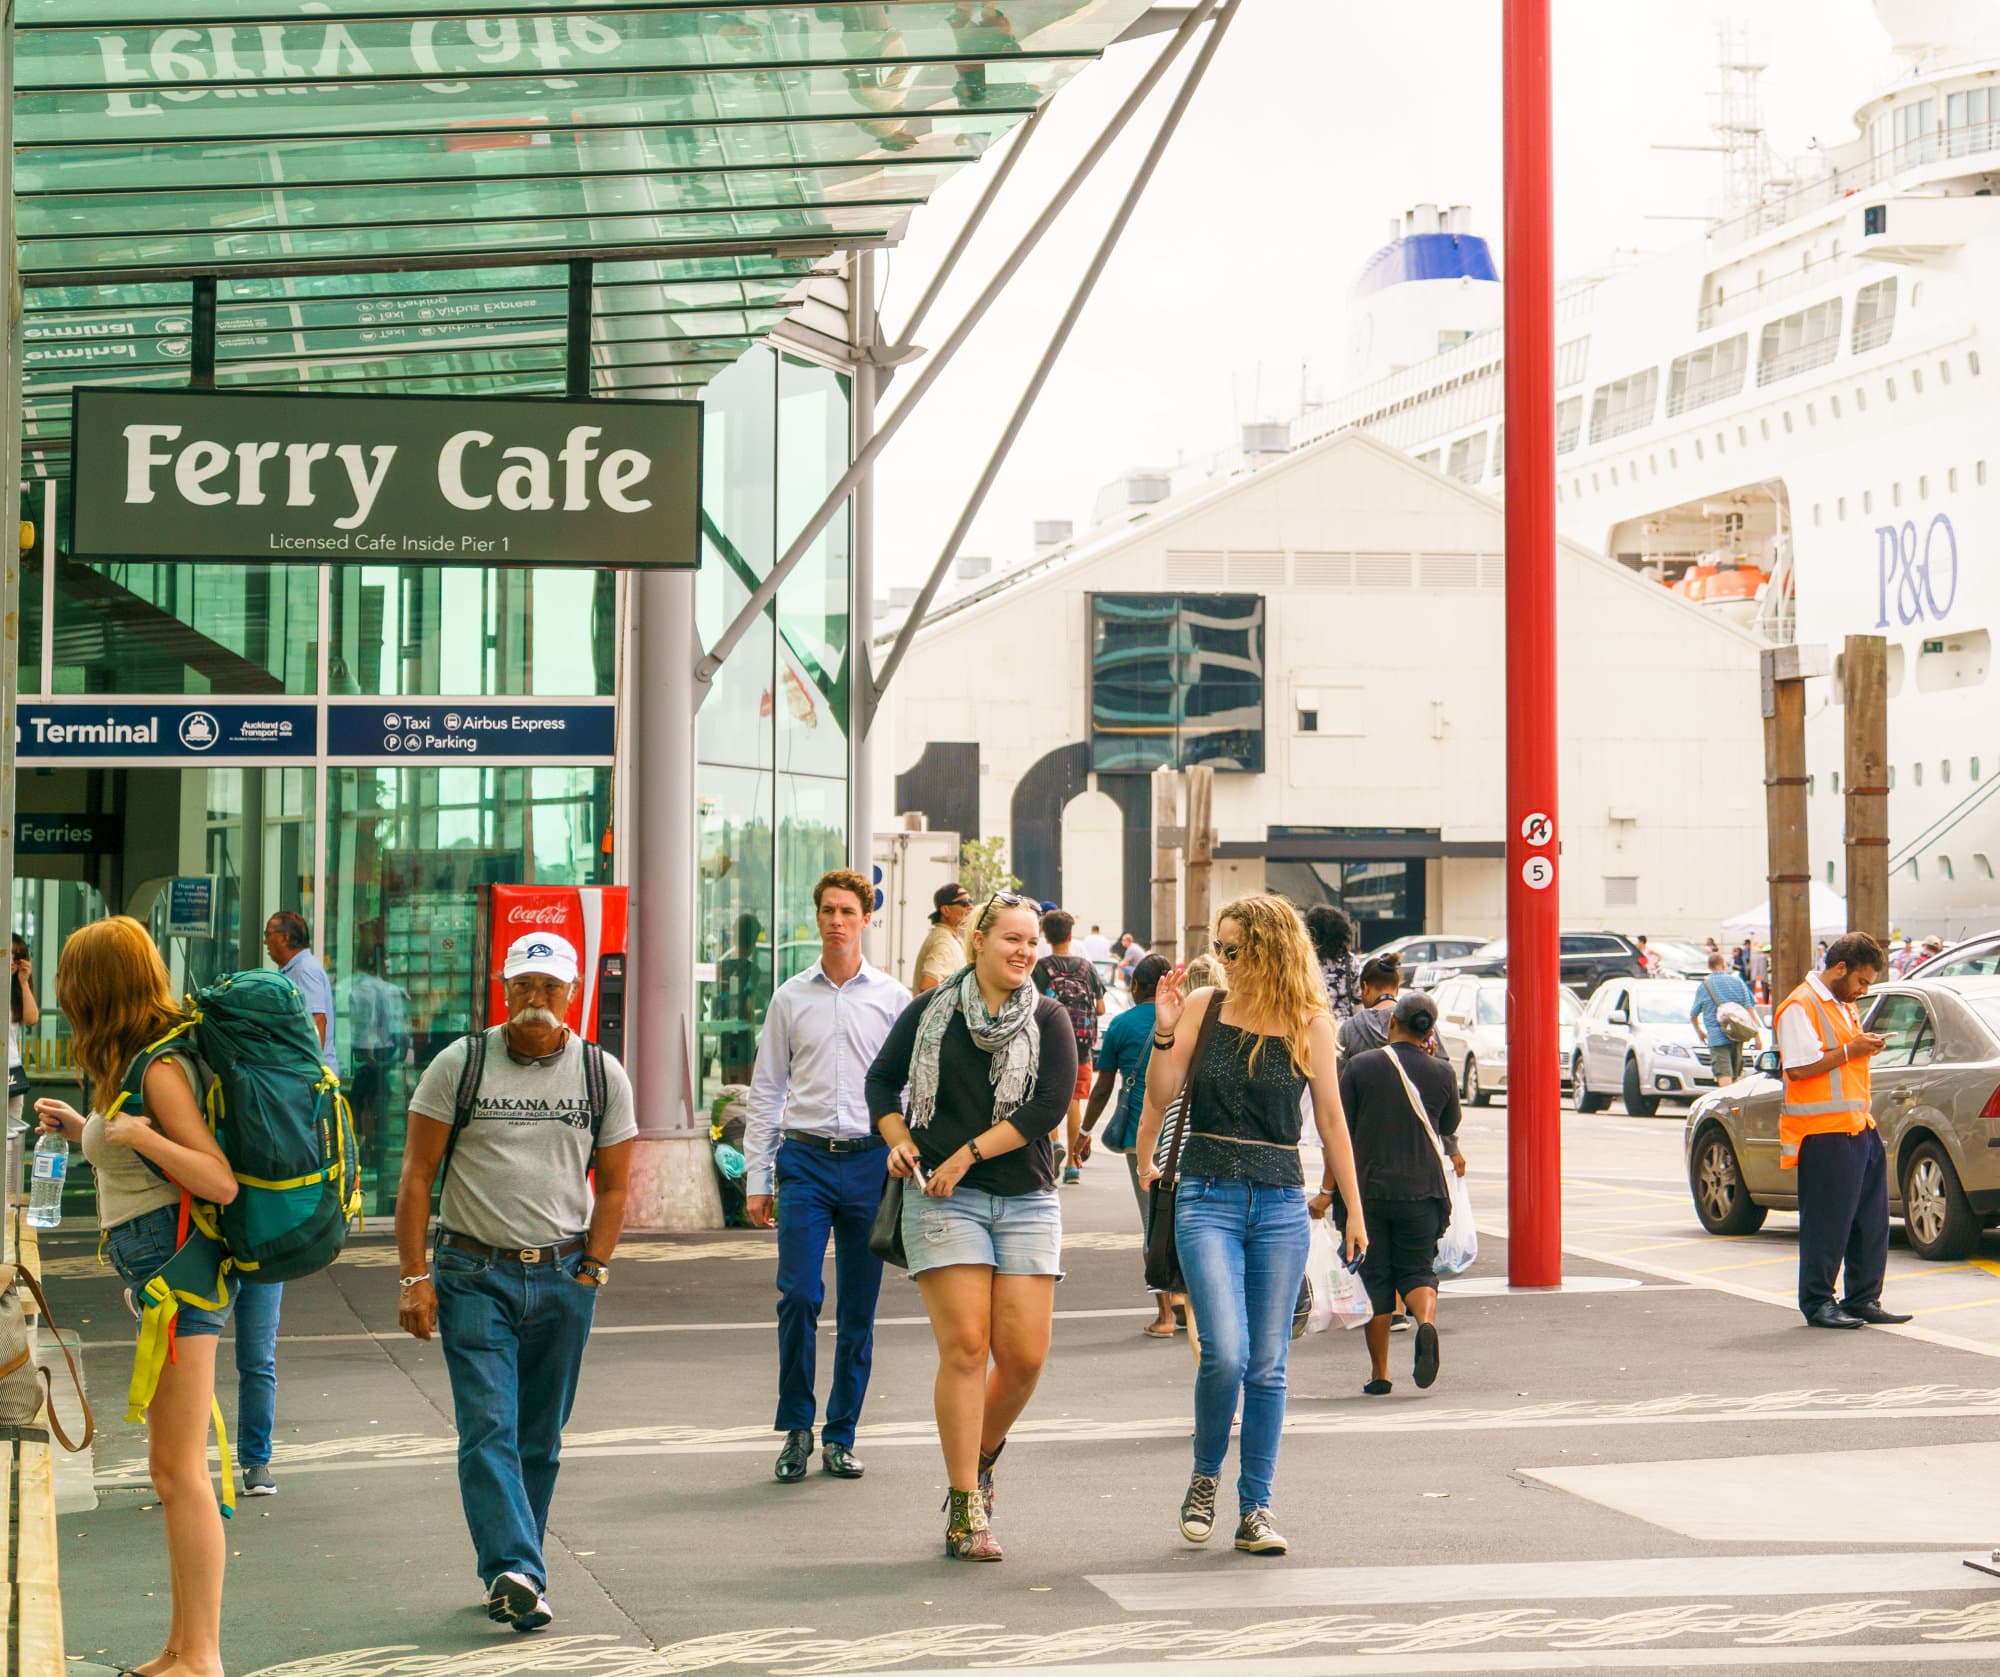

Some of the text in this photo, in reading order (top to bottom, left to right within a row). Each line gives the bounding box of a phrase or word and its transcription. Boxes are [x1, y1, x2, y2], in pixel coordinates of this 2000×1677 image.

[122, 424, 653, 529] Ferry Cafe
[269, 533, 509, 551] Licensed Cafe Inside Pier 1
[1875, 513, 1957, 628] P&O
[30, 717, 158, 743] Terminal
[242, 721, 278, 729] Auckland
[403, 716, 565, 732] Taxi Airbus Express
[240, 728, 278, 738] Transport
[425, 735, 477, 751] Parking
[21, 823, 93, 842] Ferries
[1533, 864, 1544, 881] 5
[475, 1097, 551, 1110] MAKANA
